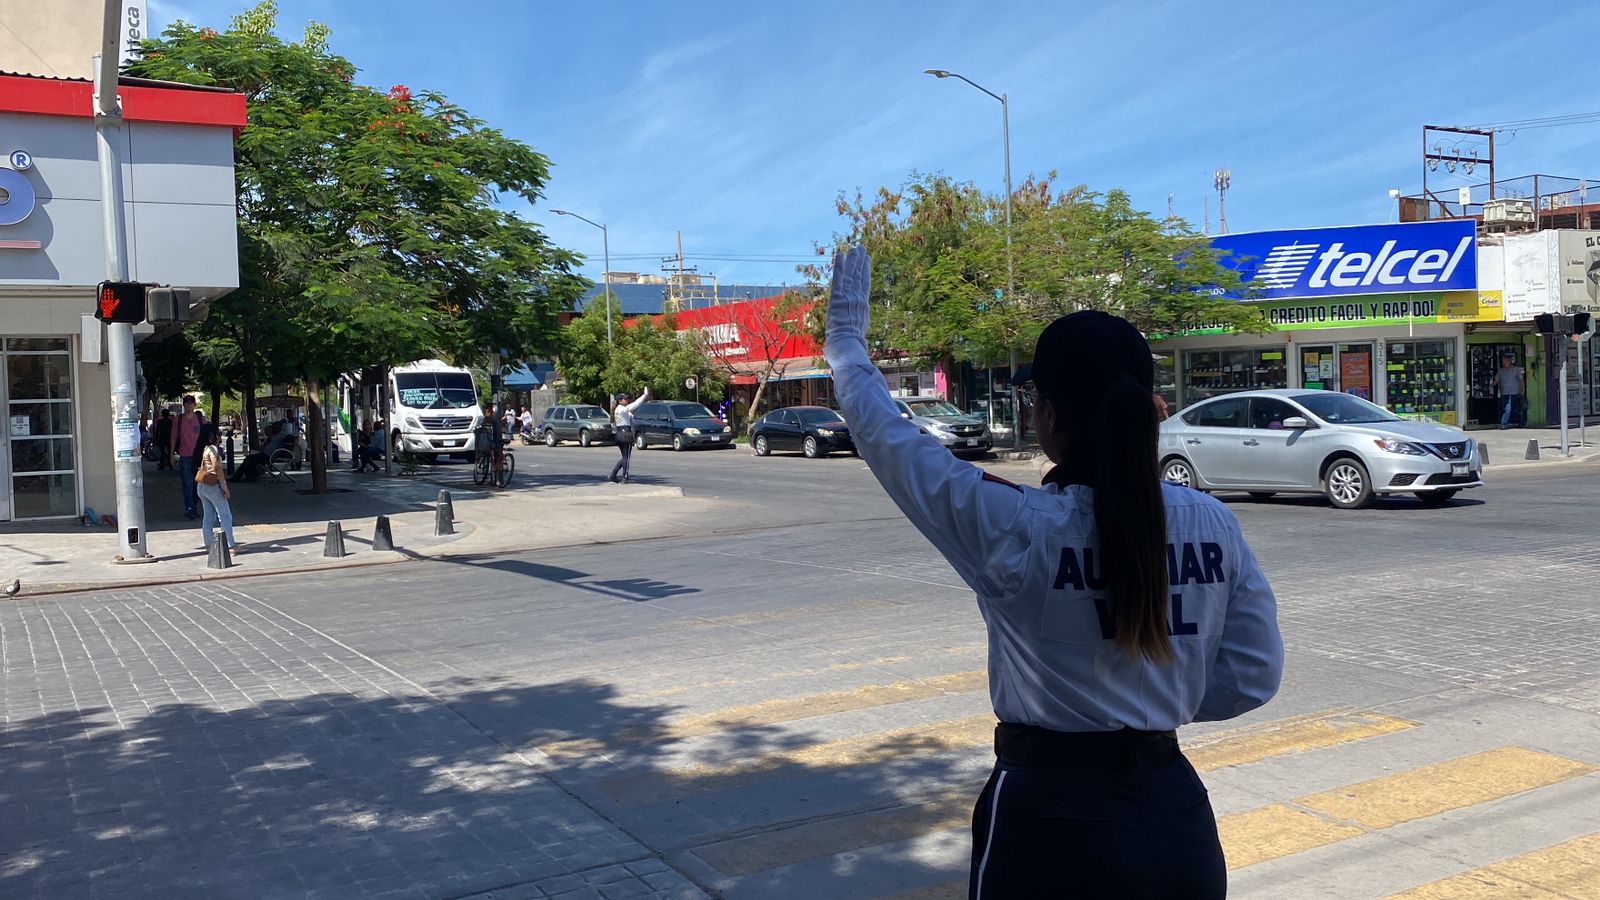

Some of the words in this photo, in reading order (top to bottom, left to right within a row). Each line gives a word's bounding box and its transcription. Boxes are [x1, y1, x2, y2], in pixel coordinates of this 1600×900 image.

[1309, 236, 1473, 288] telcel
[1270, 305, 1326, 324] CREDITO
[1330, 303, 1366, 321] FACIL
[1370, 302, 1378, 319] Y
[1382, 299, 1434, 318] RAPDO!
[1053, 542, 1226, 591] AUIAR
[1094, 593, 1198, 640] VL
